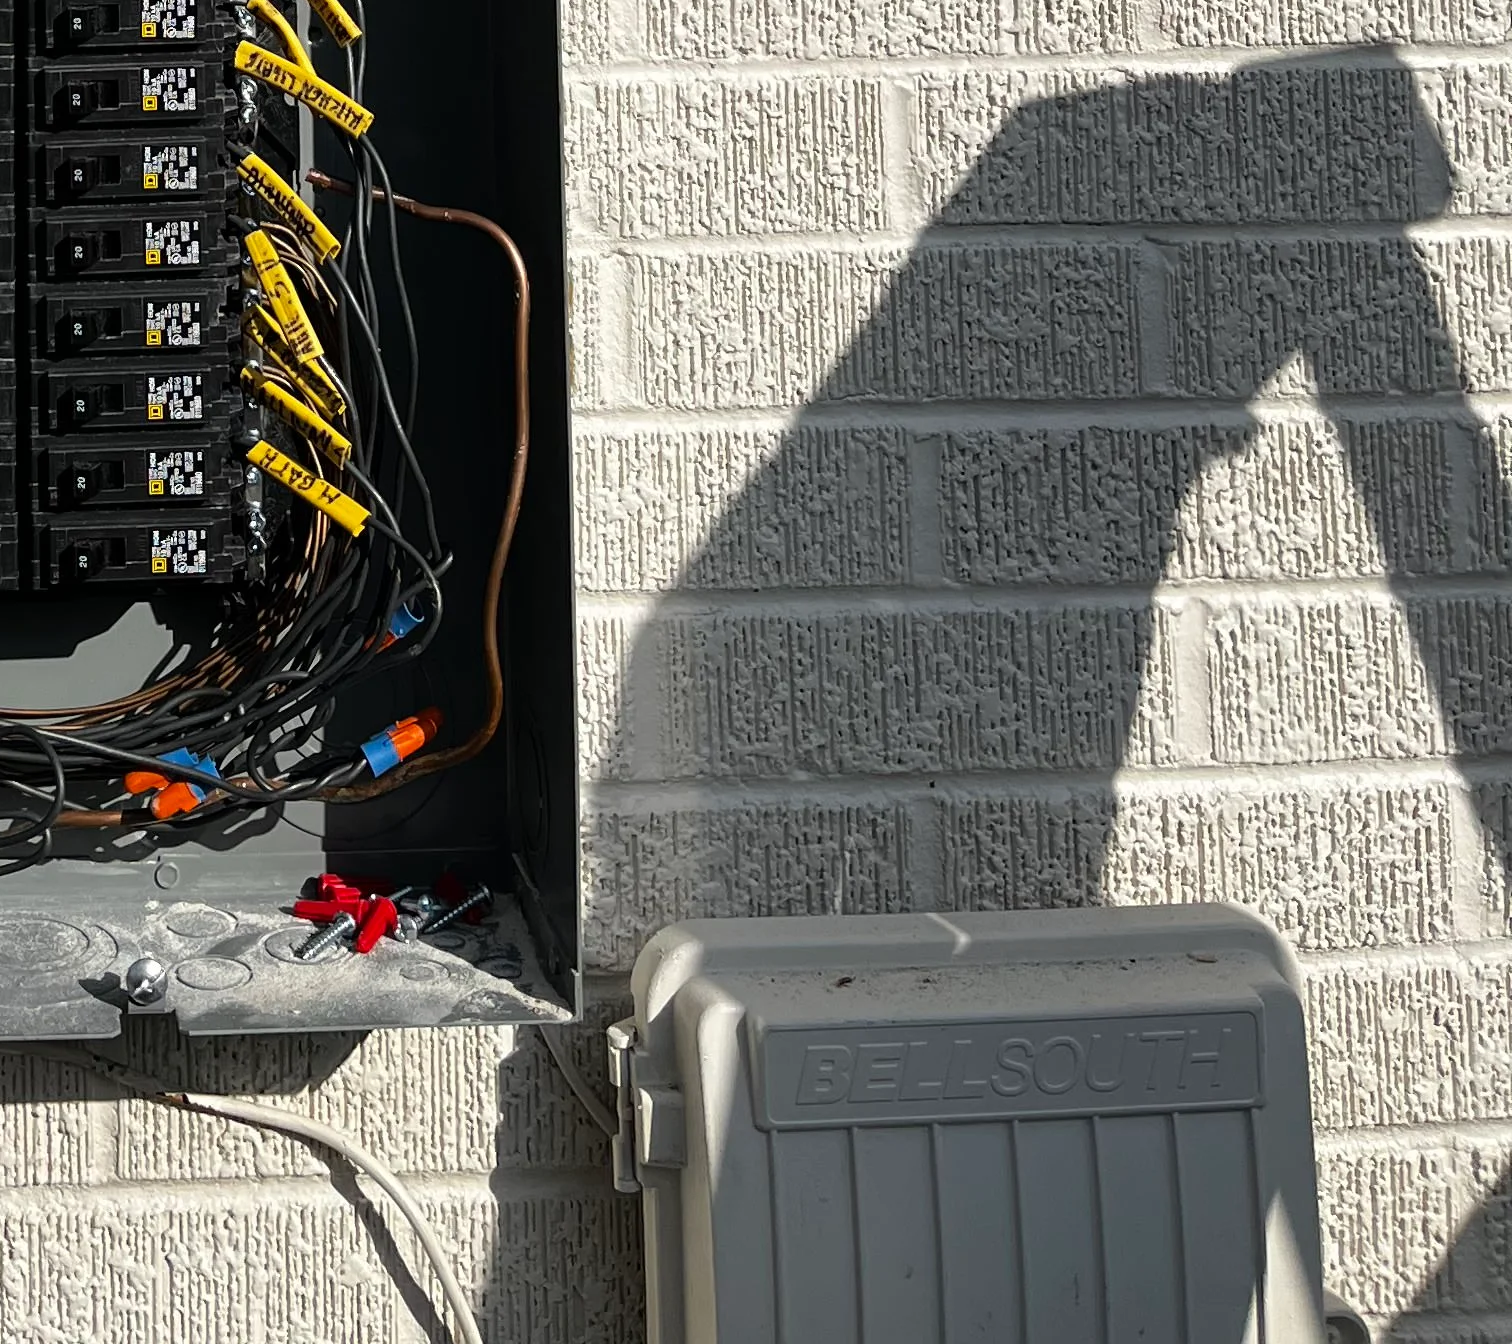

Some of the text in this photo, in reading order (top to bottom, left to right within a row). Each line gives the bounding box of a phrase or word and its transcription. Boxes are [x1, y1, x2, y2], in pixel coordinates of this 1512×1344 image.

[73, 17, 82, 30] 20
[72, 93, 81, 106] 20
[74, 168, 83, 182] 20
[74, 246, 83, 259] 20
[73, 322, 83, 336] 20
[76, 399, 85, 412] 20
[77, 476, 86, 489] 20
[78, 555, 88, 568] 20
[796, 1027, 1231, 1105] BELLSOUTH
